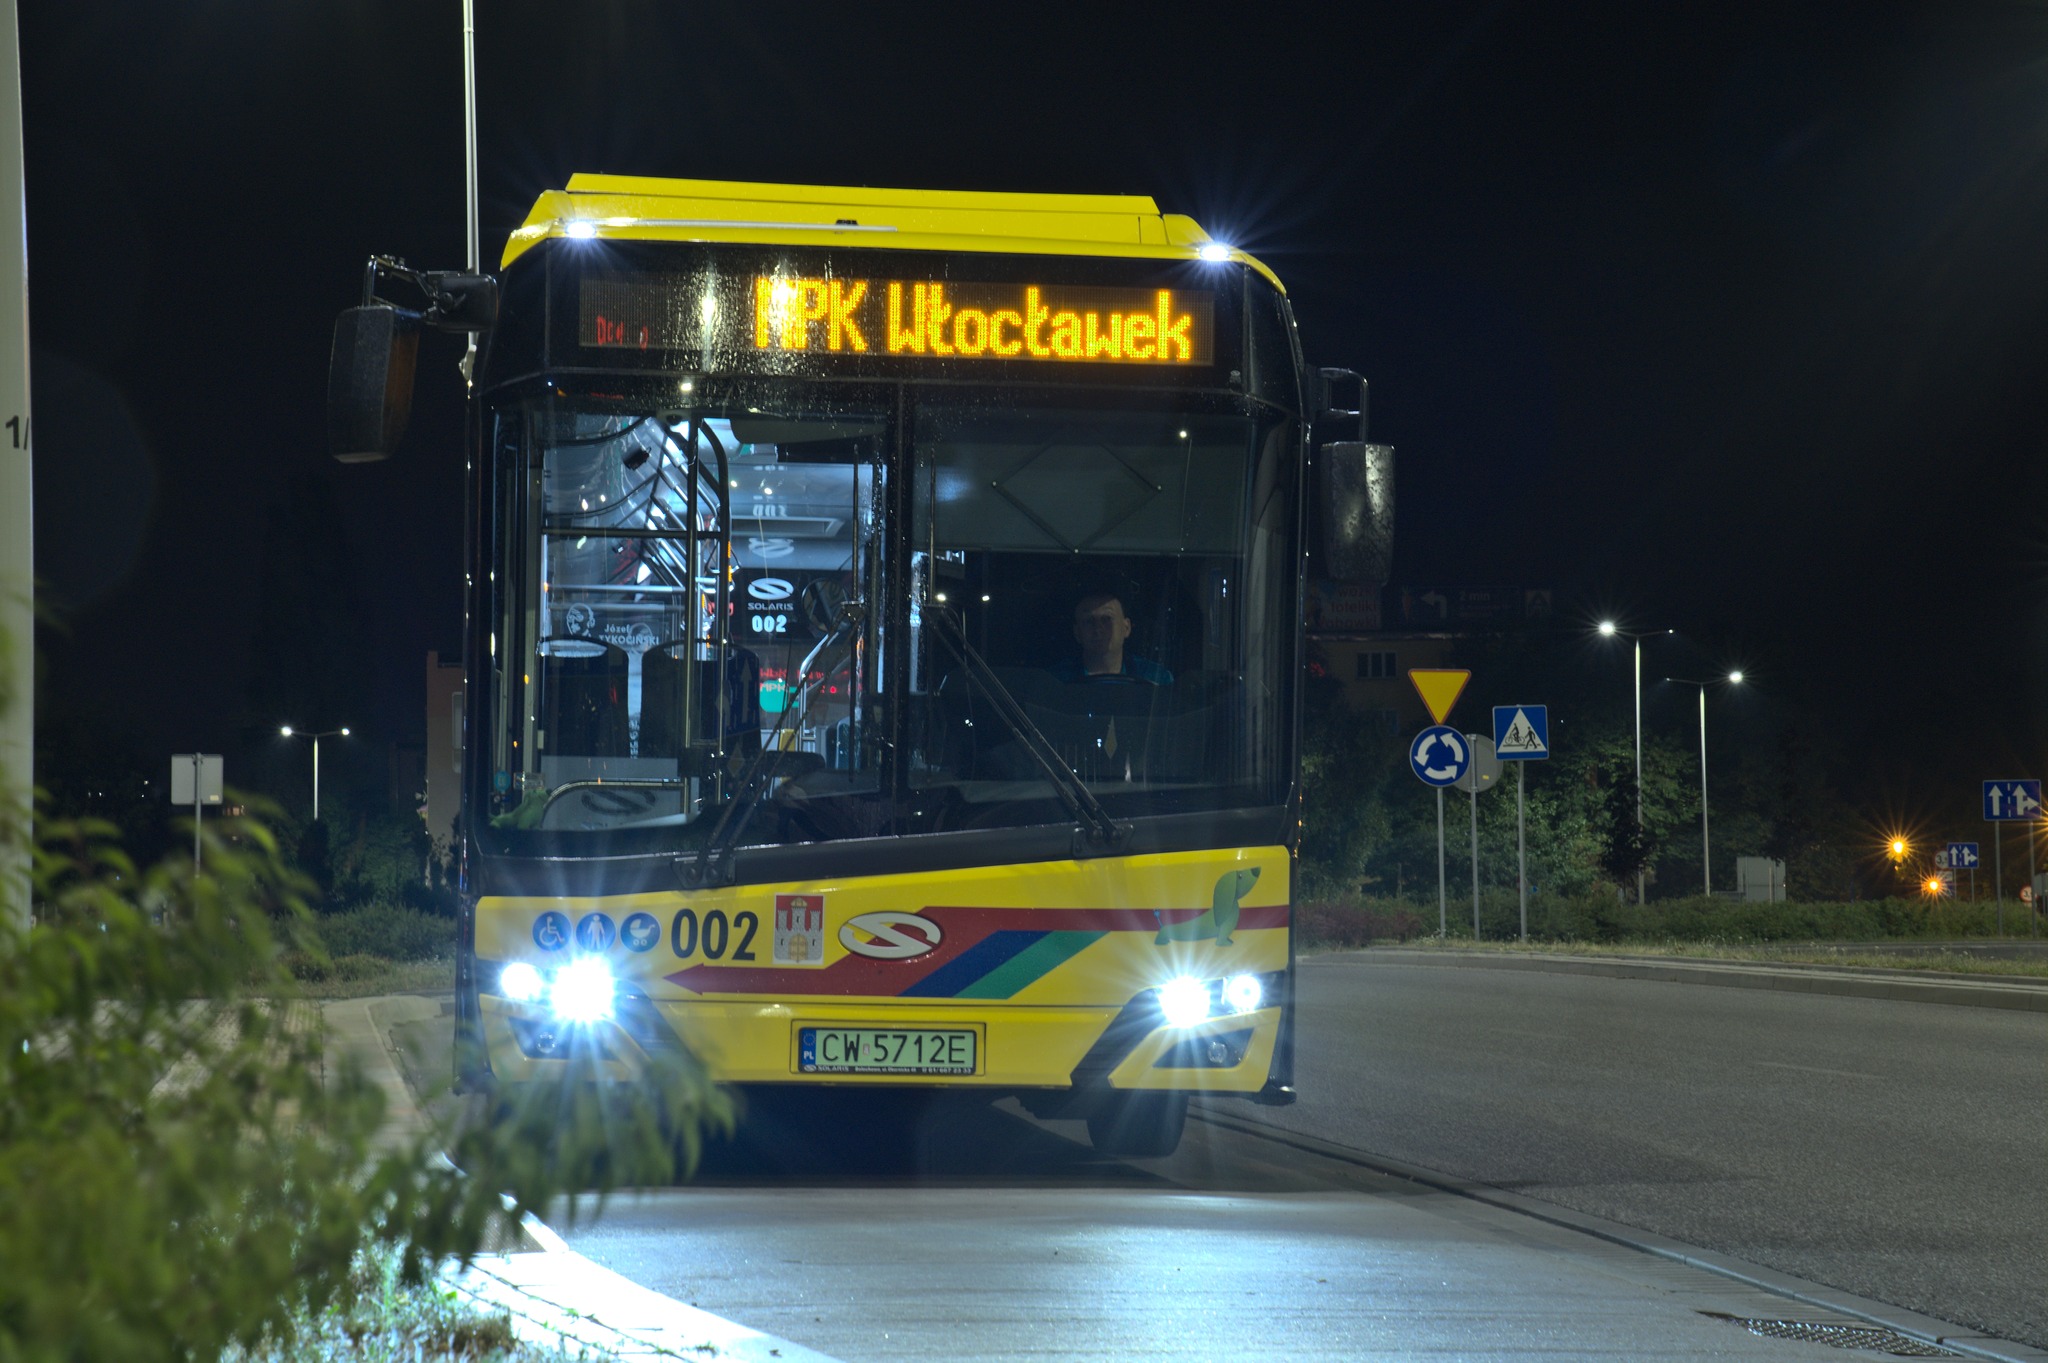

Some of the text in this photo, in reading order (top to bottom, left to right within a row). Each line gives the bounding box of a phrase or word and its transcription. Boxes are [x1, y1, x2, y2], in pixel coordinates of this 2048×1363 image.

[888, 282, 1191, 361] Włocławek
[747, 602, 794, 611] SOLARIS
[604, 624, 631, 633] Józef
[751, 614, 787, 633] 002
[670, 907, 759, 961] 002
[803, 1051, 814, 1061] PL
[822, 1033, 966, 1064] CW 5712E
